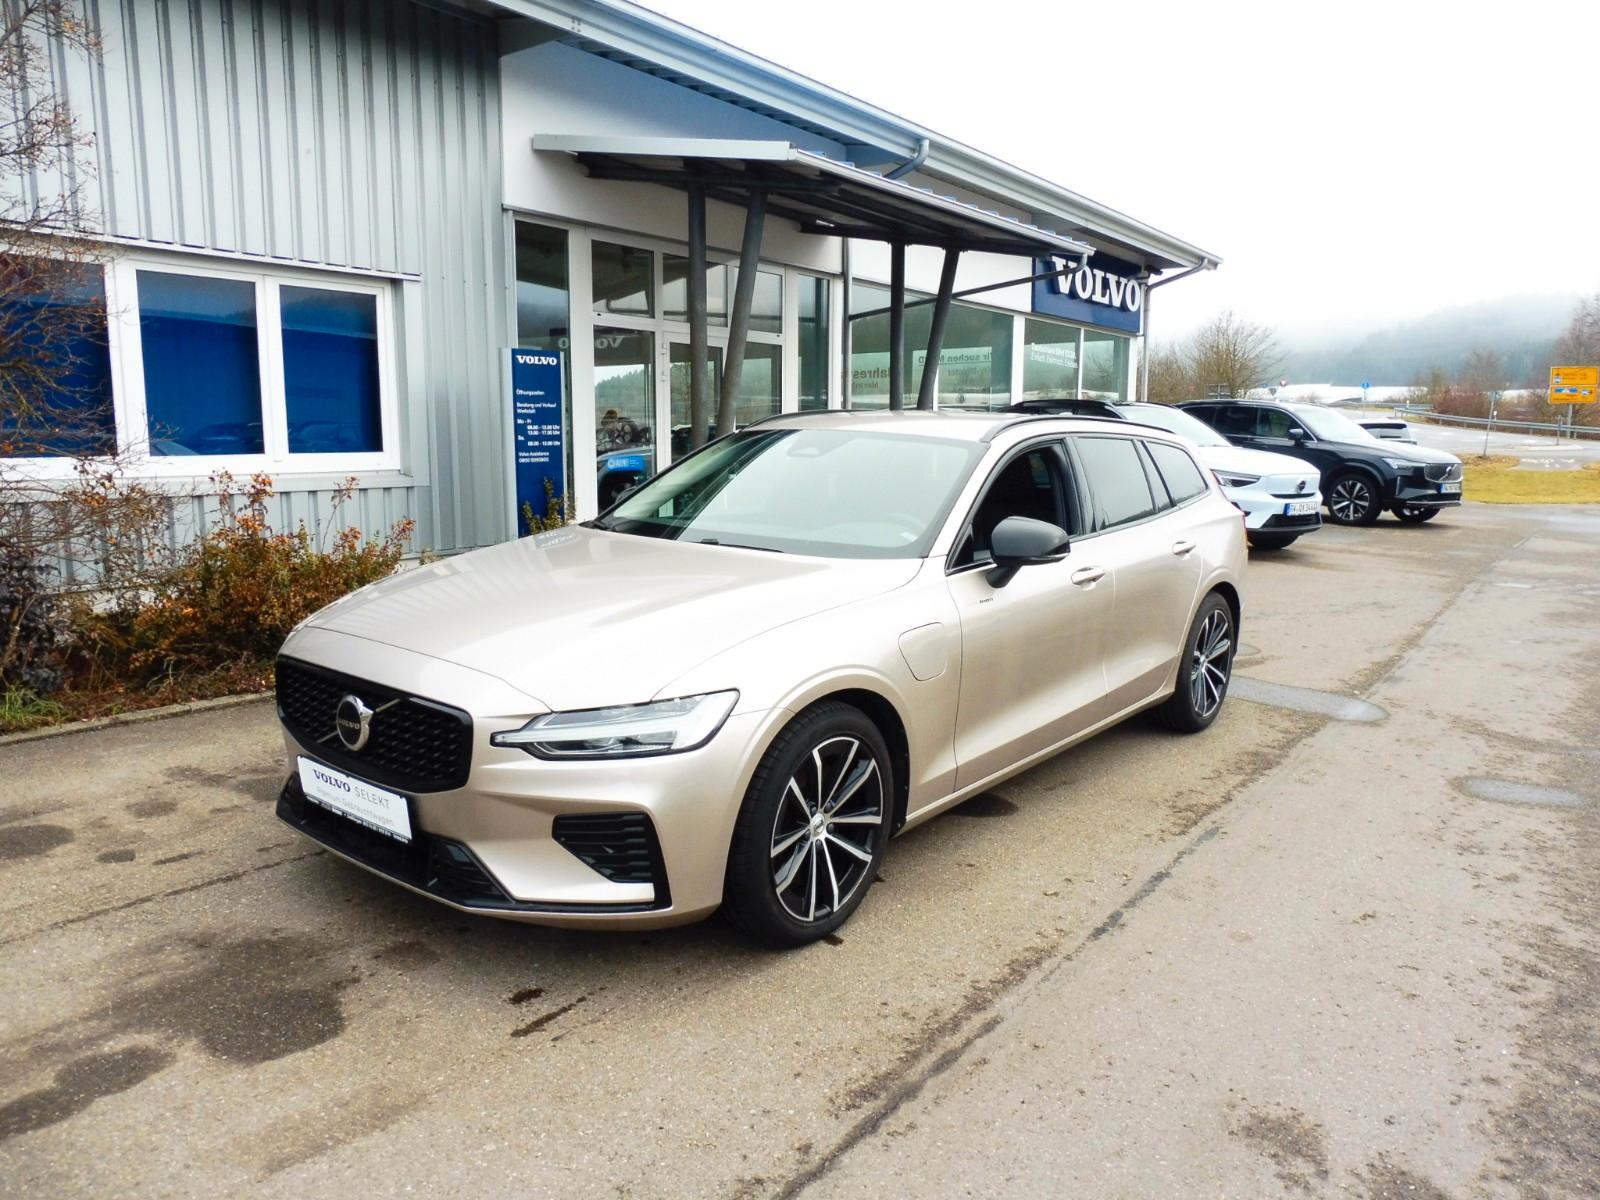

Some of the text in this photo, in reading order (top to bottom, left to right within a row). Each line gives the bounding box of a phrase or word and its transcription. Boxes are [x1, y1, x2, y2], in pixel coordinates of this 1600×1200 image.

[1052, 256, 1140, 312] VOLVO
[516, 355, 557, 365] VOLVO
[338, 718, 360, 729] VOLVO
[313, 769, 351, 793] VOLVO
[354, 786, 389, 808] SELEKT
